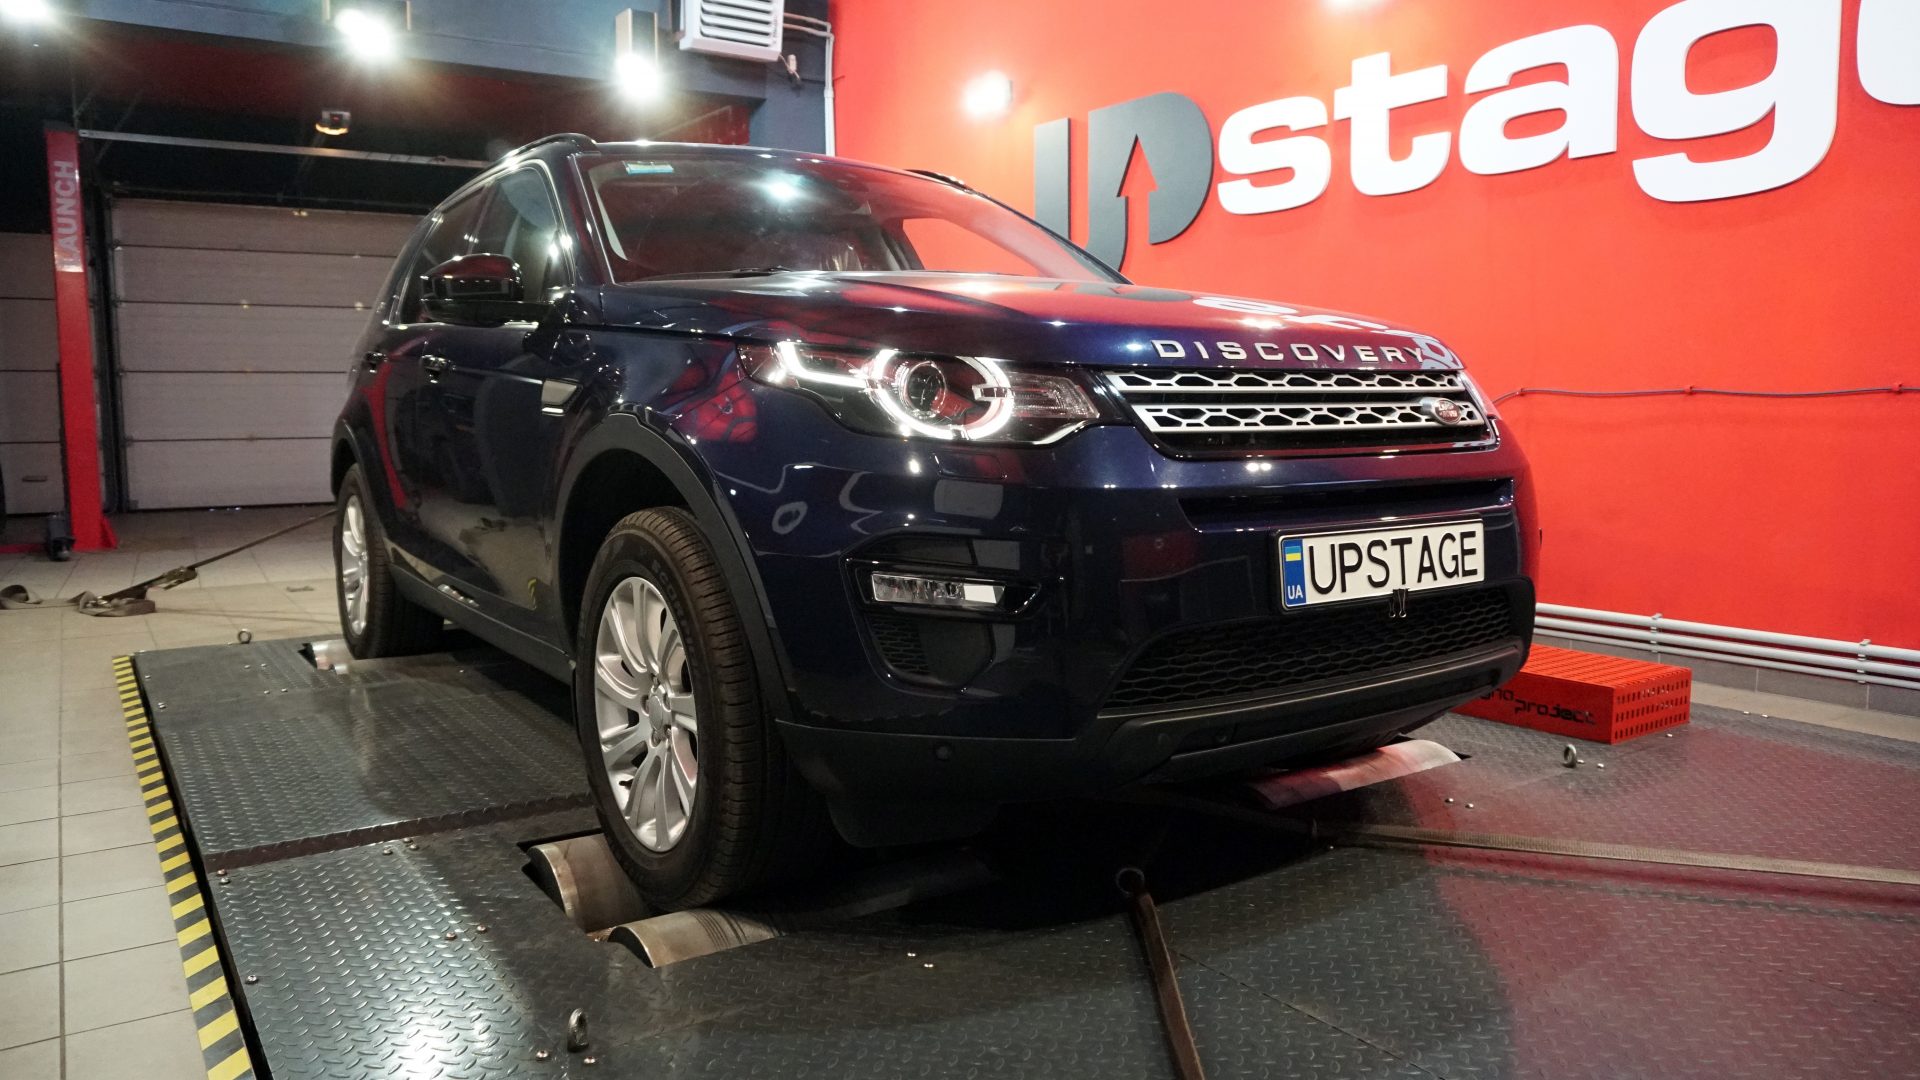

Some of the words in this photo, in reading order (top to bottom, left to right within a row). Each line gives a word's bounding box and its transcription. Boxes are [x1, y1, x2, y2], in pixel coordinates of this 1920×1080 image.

[54, 160, 82, 268] LAUNCH
[1151, 339, 1425, 363] DISCOVERY
[1308, 531, 1478, 595] UPSTAGE
[1287, 585, 1304, 600] UA
